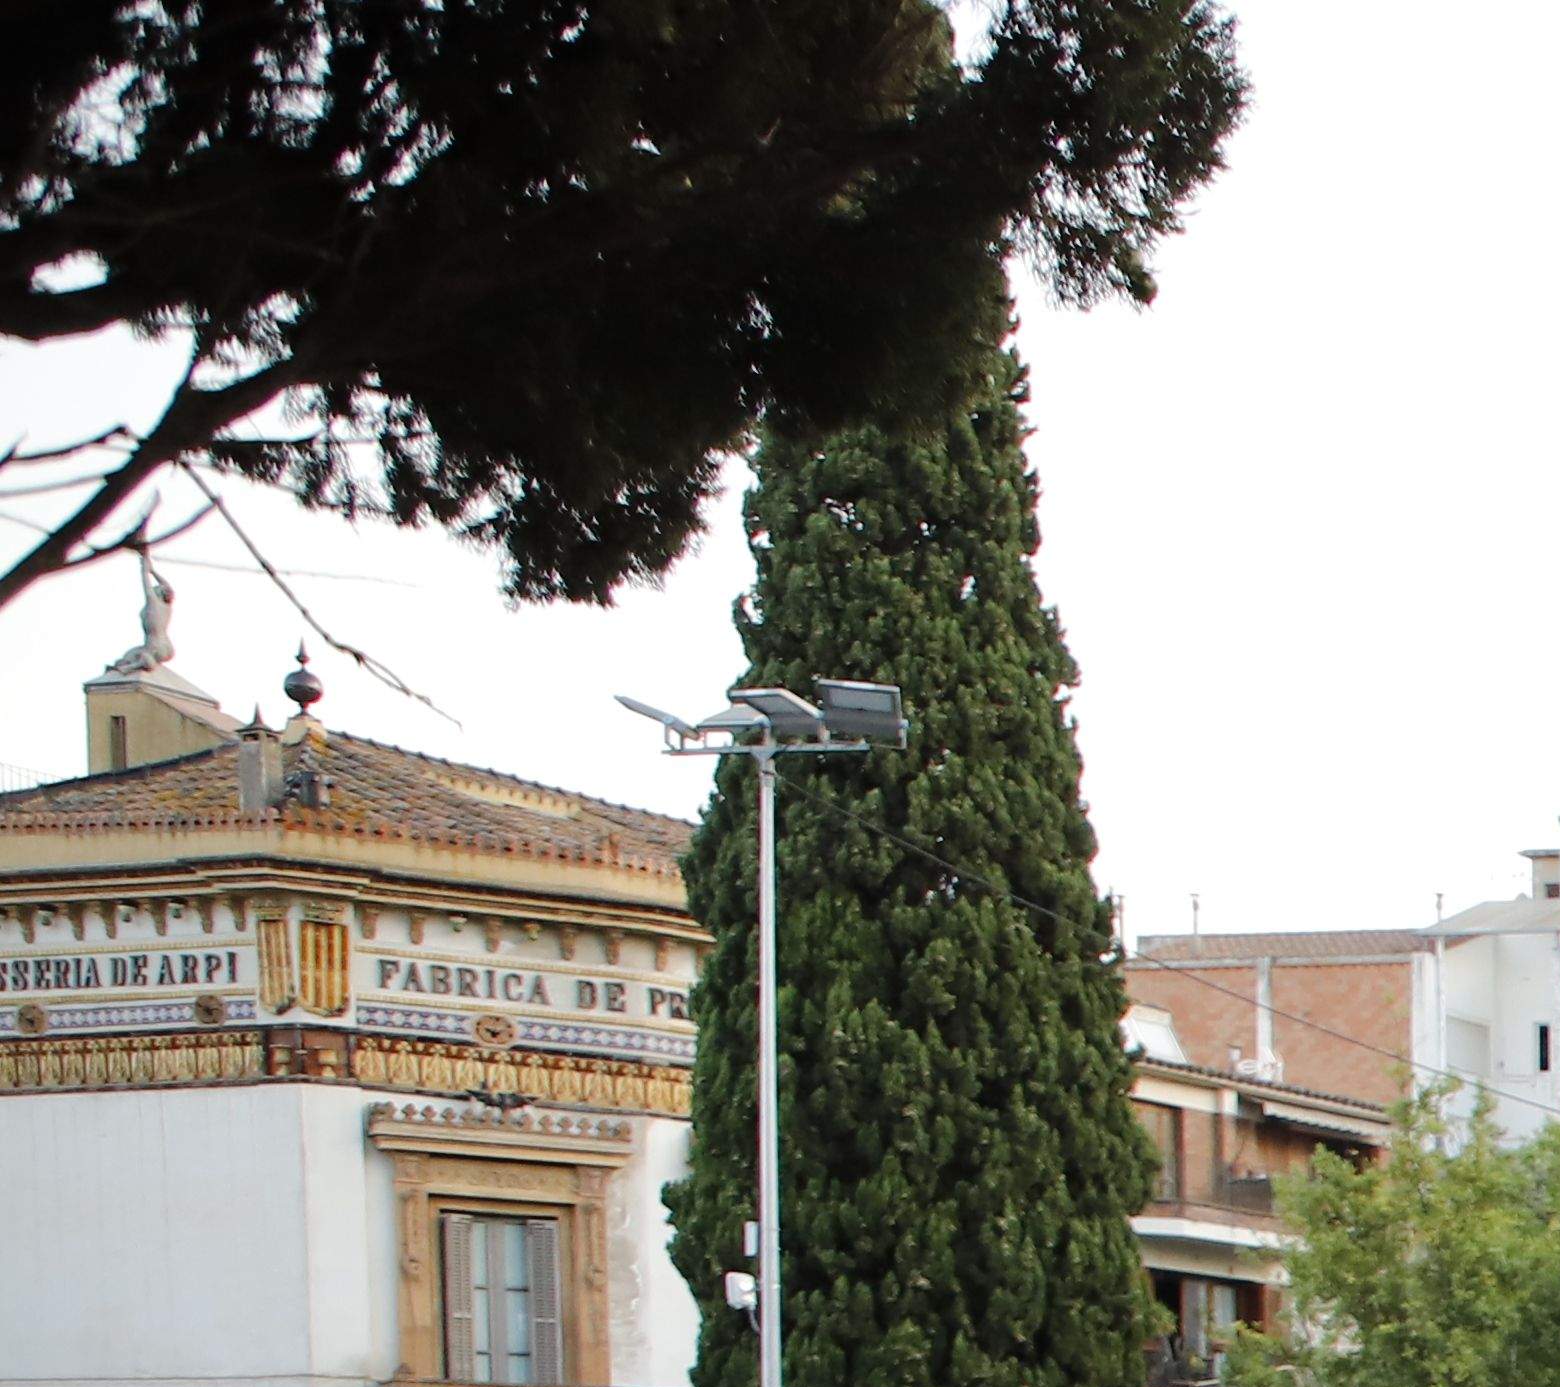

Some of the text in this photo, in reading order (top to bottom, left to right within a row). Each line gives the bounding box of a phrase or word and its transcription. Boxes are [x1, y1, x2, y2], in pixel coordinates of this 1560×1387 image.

[110, 954, 148, 987] DE
[157, 951, 238, 984] ARPI
[377, 958, 551, 1006] FABRICA
[577, 979, 627, 1013] DE
